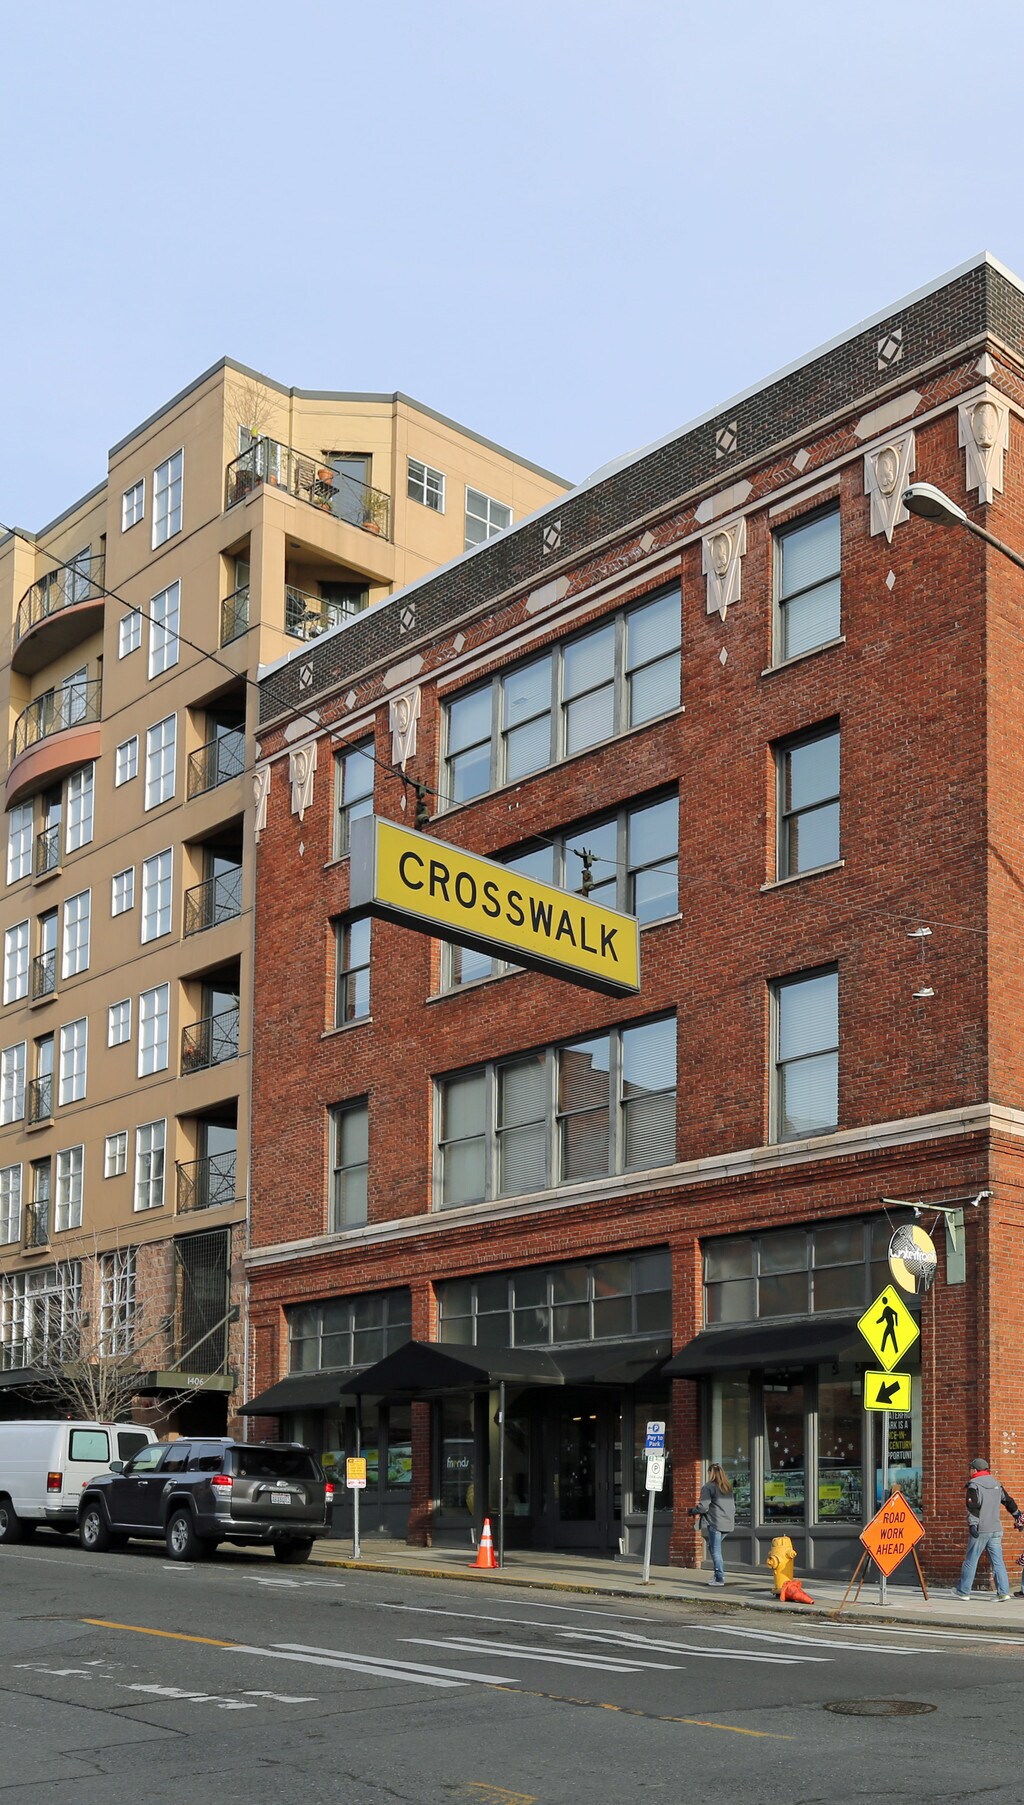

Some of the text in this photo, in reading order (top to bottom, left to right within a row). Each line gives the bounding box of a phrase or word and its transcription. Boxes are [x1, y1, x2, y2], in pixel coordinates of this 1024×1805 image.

[399, 851, 619, 962] CROSSWALK
[187, 1377, 204, 1386] 1406
[883, 1511, 906, 1524] ROAD
[880, 1527, 905, 1540] WORK
[876, 1543, 905, 1556] AHEAD
